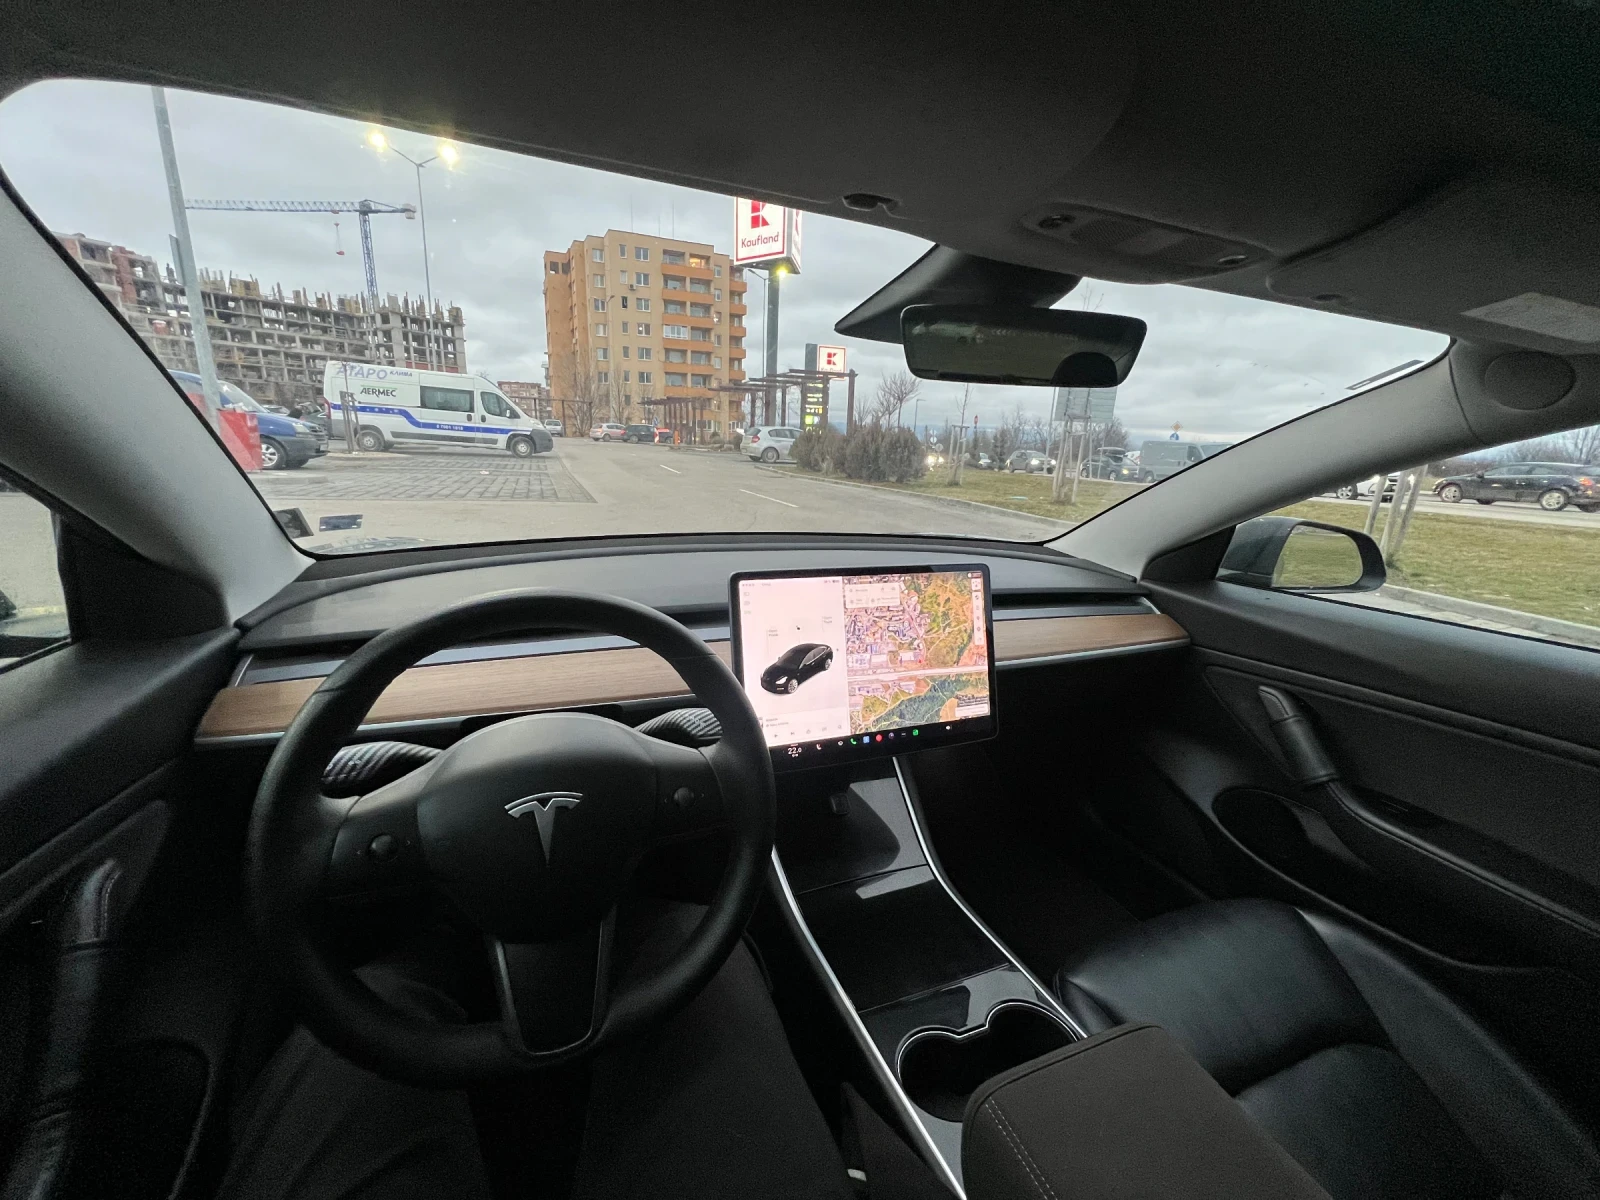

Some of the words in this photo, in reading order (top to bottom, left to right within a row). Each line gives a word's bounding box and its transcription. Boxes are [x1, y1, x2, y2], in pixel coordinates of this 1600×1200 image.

[741, 232, 780, 248] Kaufland
[360, 387, 397, 398] AERMEC
[787, 747, 803, 755] 22.0
